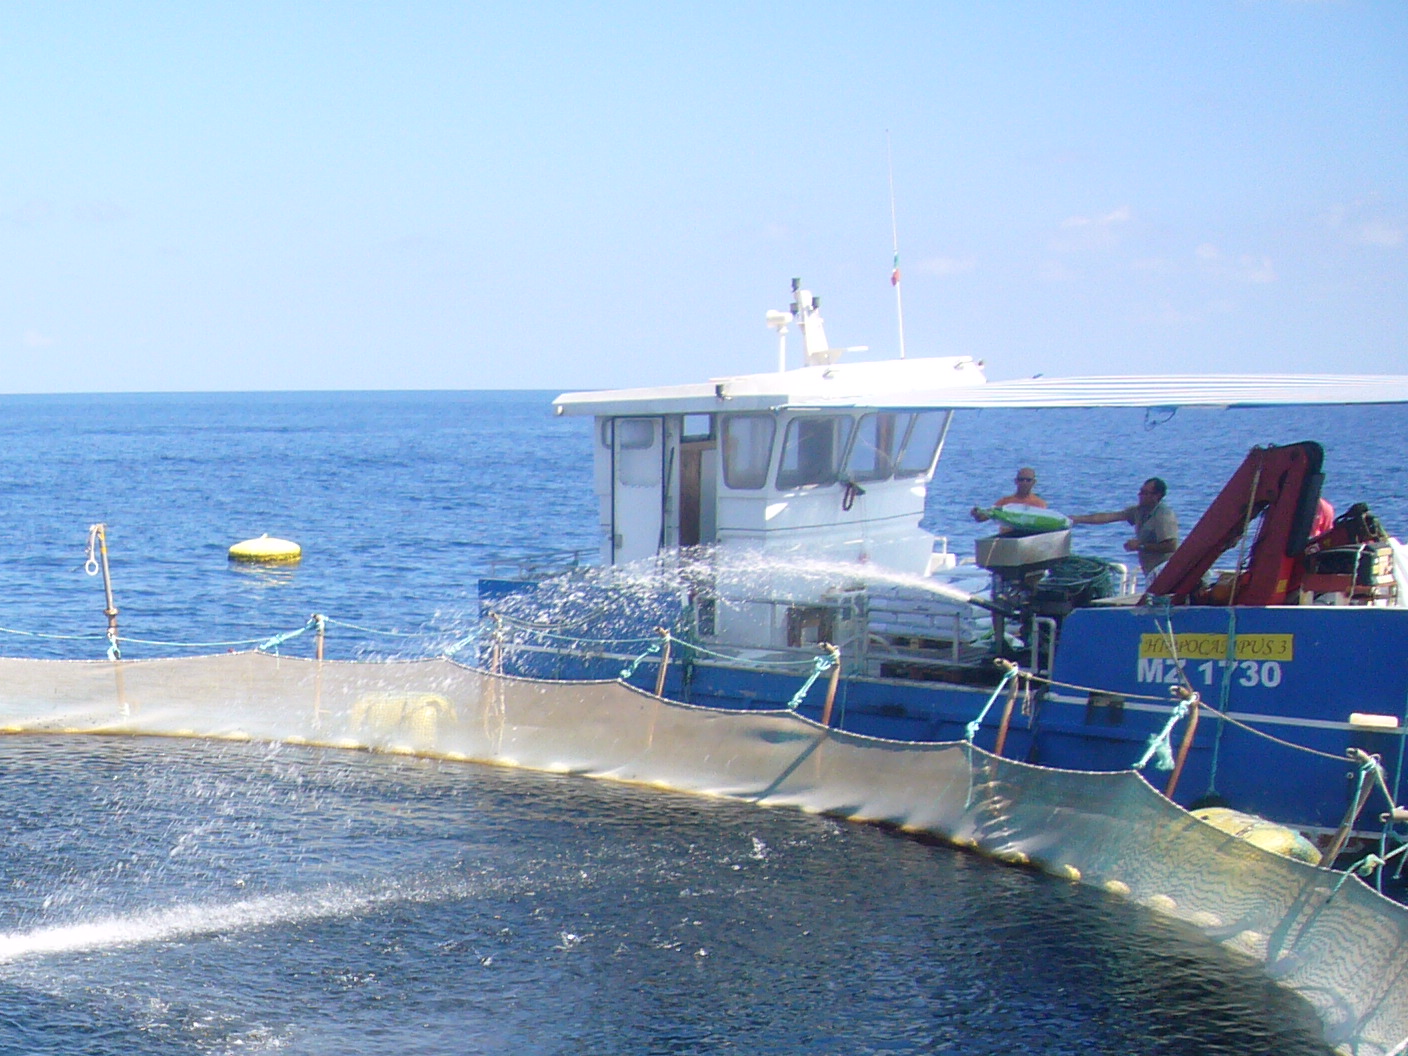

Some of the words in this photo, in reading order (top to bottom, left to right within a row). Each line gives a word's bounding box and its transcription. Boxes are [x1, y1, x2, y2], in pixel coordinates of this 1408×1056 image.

[1278, 639, 1288, 655] 3
[1137, 658, 1187, 685] MZ
[1198, 660, 1282, 688] 1730
